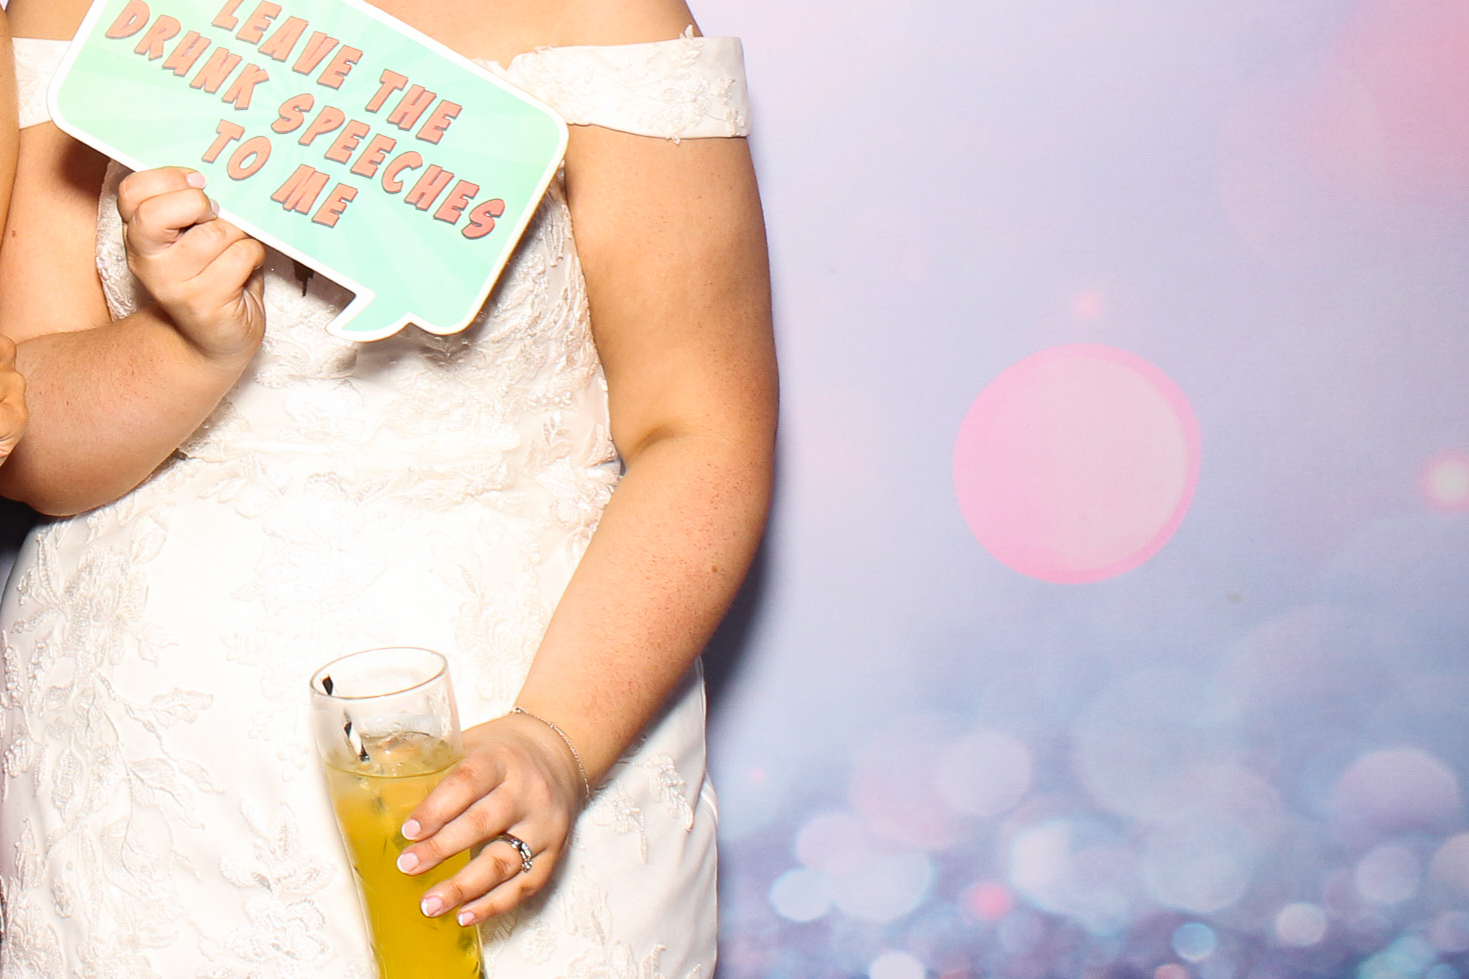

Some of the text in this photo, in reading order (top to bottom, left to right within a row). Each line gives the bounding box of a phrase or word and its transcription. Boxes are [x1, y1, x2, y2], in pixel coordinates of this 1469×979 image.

[365, 68, 462, 145] THE
[201, 118, 358, 229] TO ME
[271, 93, 506, 241] SPEECHES
